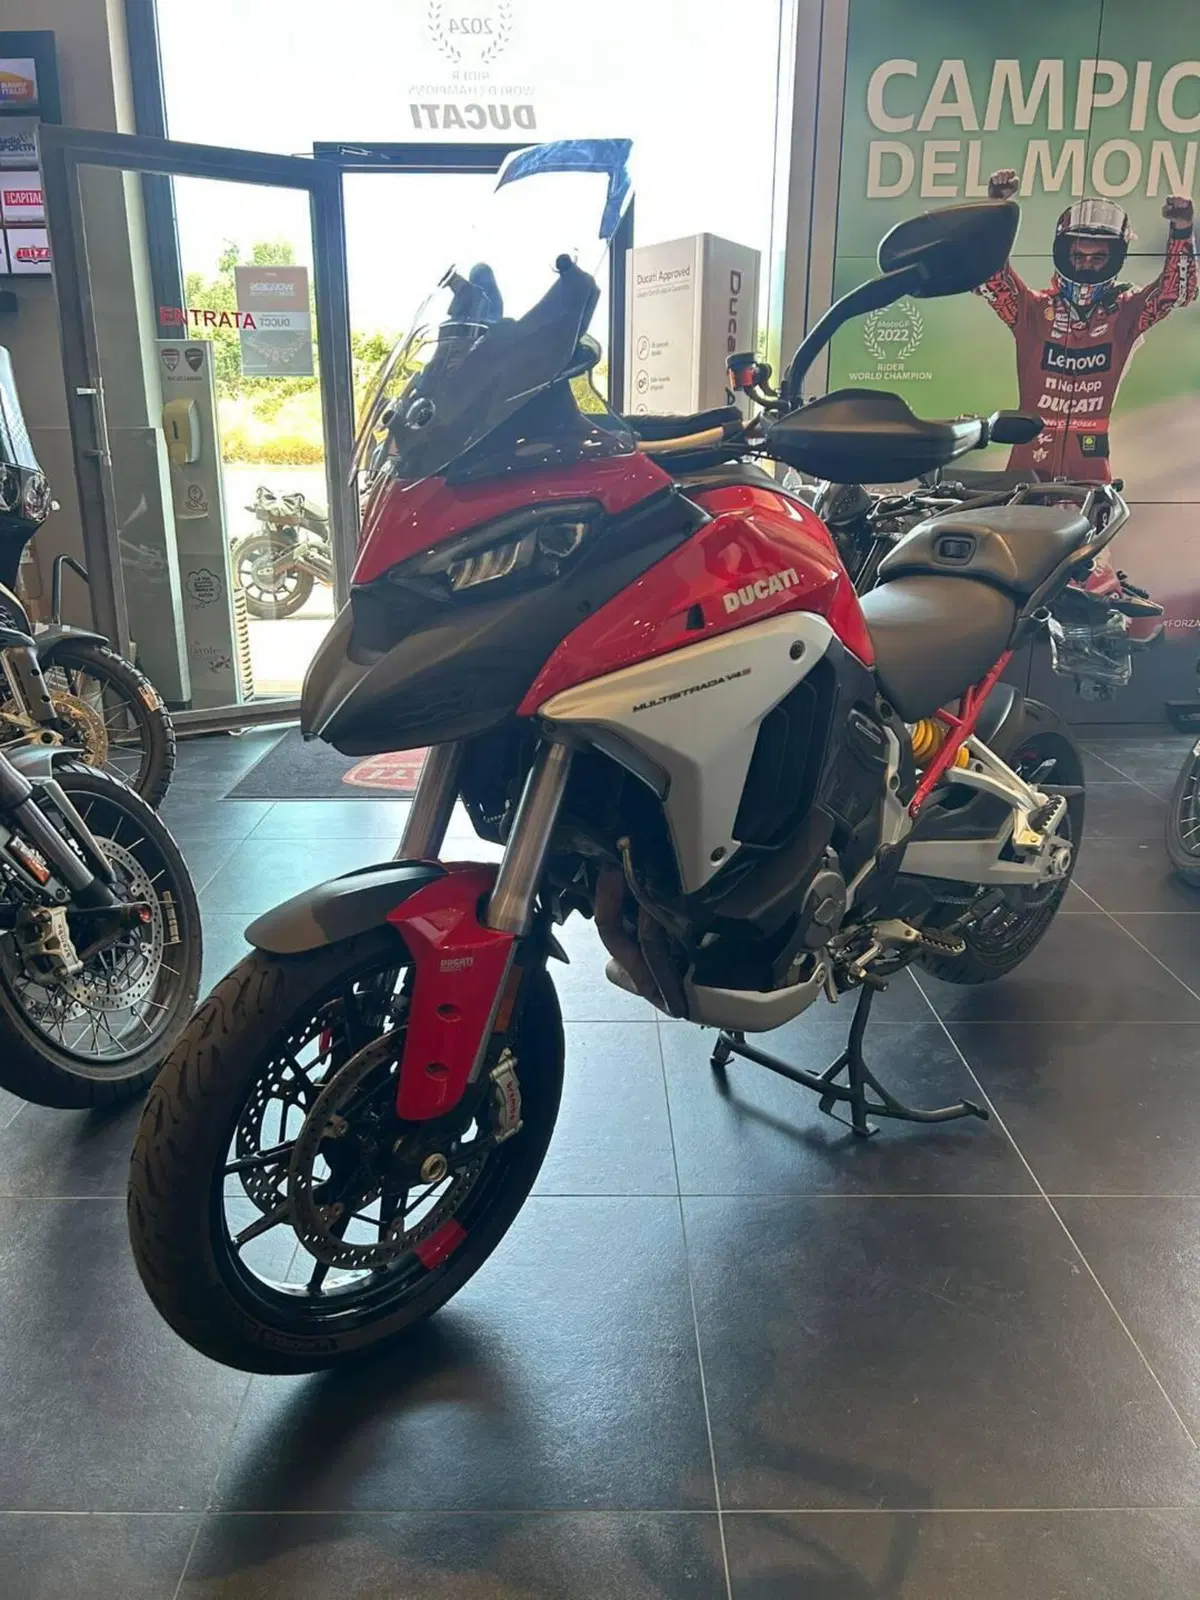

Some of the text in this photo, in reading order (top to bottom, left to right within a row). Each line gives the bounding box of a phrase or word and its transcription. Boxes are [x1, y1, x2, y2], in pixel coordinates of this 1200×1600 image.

[866, 58, 1200, 134] CAMPIO
[867, 138, 1199, 199] DEL MON
[637, 264, 691, 285] Ducati Approved
[160, 306, 257, 330] ENTRATA
[876, 329, 909, 341] 2022
[877, 363, 905, 371] RIDER
[1047, 349, 1106, 370] Lenovo
[849, 372, 933, 380] WORLD CHAMPION
[1058, 380, 1102, 393] NetApp
[1037, 394, 1104, 414] DUCATI
[723, 568, 800, 614] DUCATI
[633, 677, 725, 713] MULTISTRADA
[441, 957, 474, 968] DUCATI
